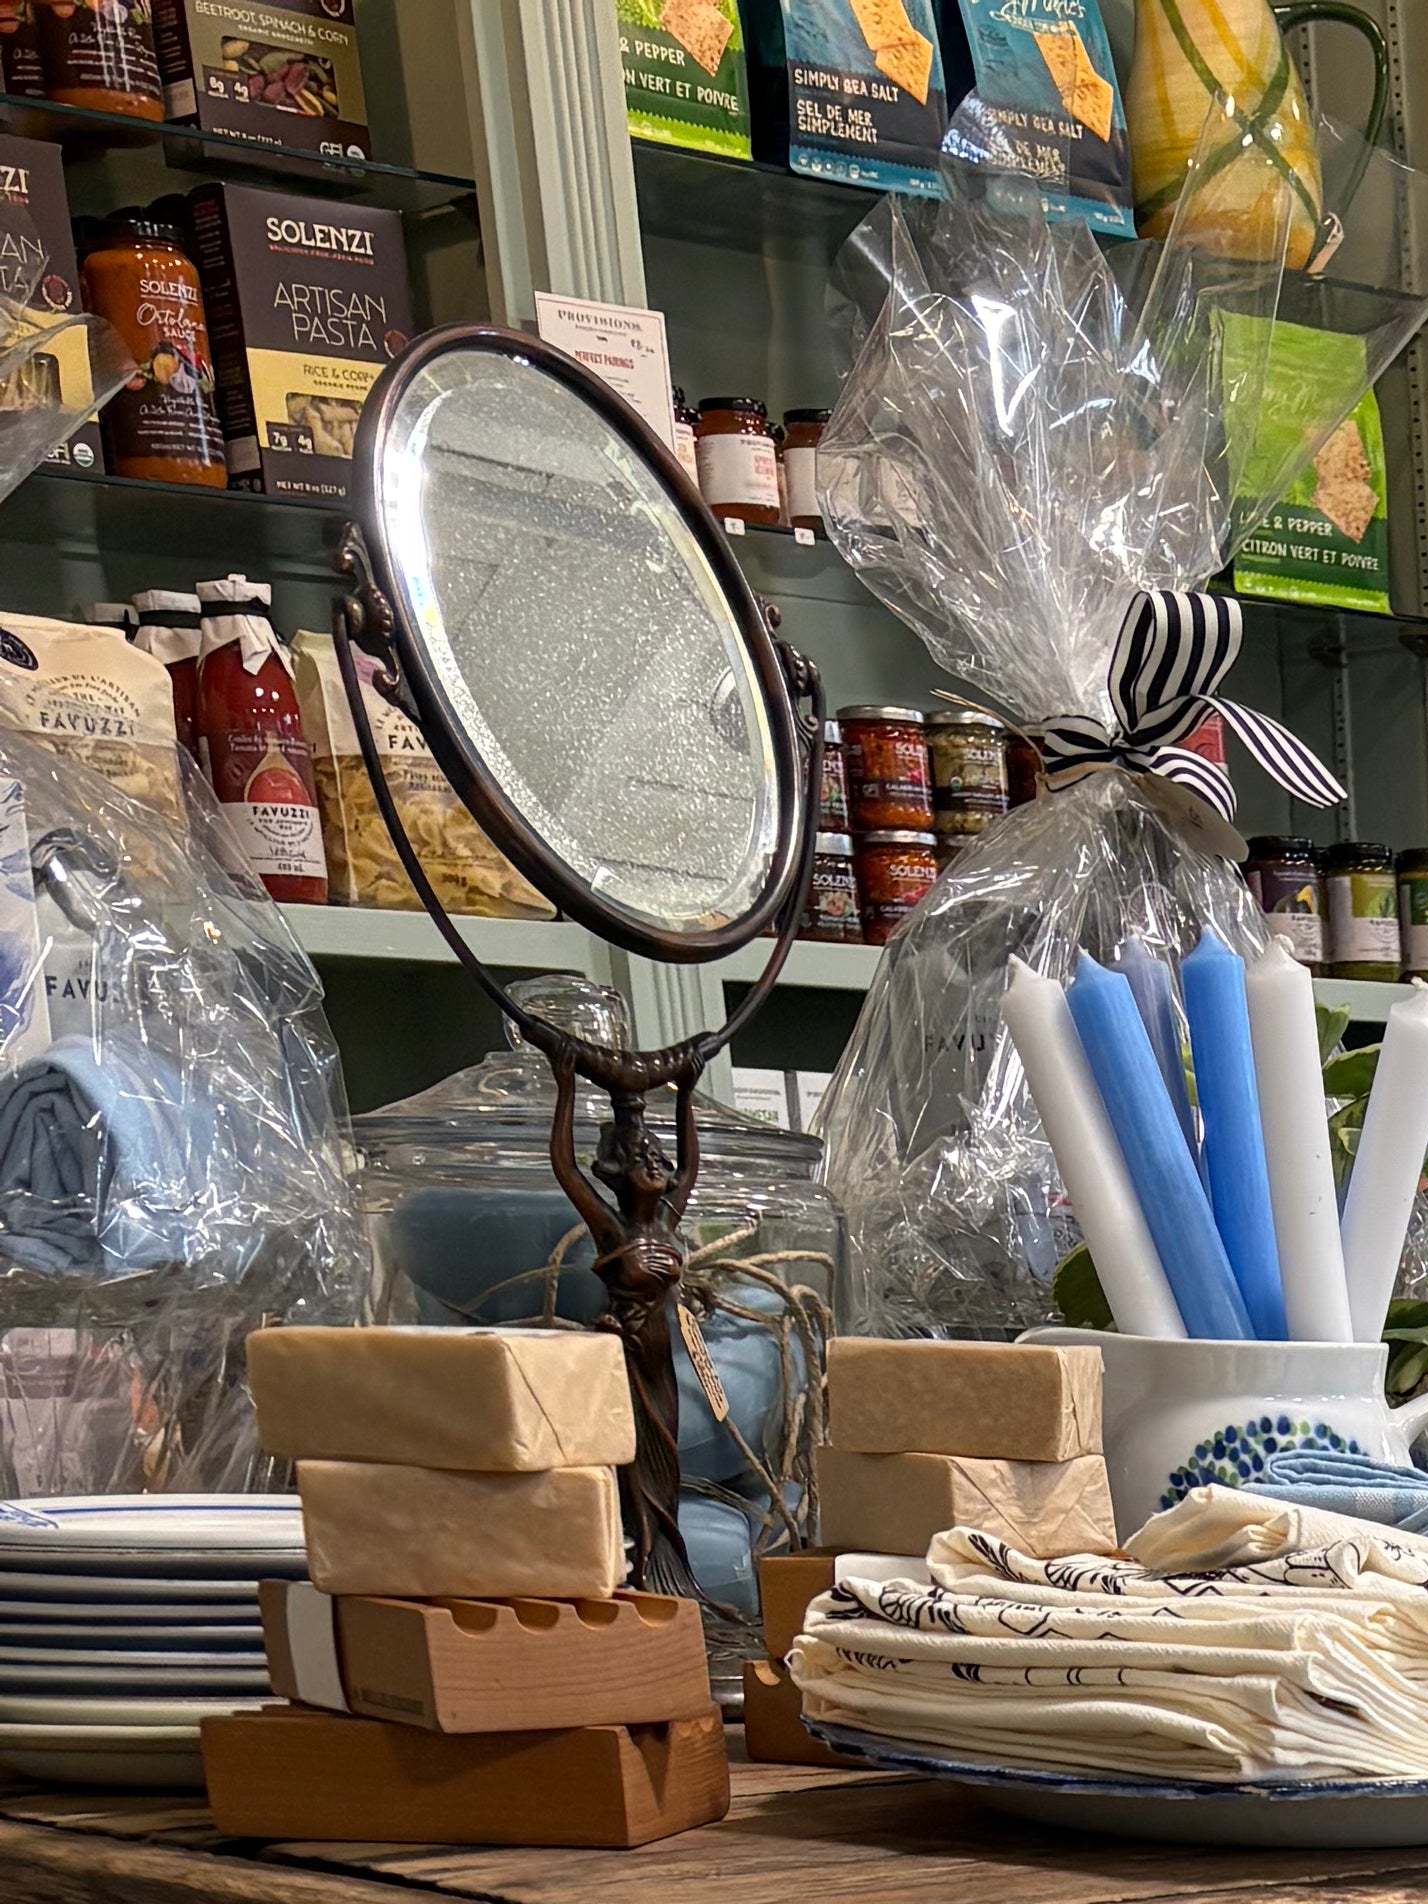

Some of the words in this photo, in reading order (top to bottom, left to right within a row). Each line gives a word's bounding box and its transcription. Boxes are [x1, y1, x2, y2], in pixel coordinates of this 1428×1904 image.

[258, 13, 307, 36] SPINACH
[633, 39, 685, 67] PEPPER
[639, 72, 671, 94] VERT
[675, 80, 692, 99] ET
[696, 86, 740, 112] POIVRE
[794, 68, 839, 91] SIMPLY
[870, 83, 900, 103] SALT
[796, 99, 823, 118] SEL
[826, 104, 842, 121] DE
[847, 108, 873, 126] MER
[265, 216, 375, 257] SOLENZI
[139, 279, 199, 302] SOLENZI
[273, 281, 388, 325] ARTISAN
[290, 312, 378, 351] PASTA
[303, 363, 330, 379] RICE
[1273, 515, 1284, 530] &
[1287, 518, 1334, 537] PEPPER
[1241, 538, 1288, 558] CITRON
[1290, 544, 1320, 562] VERT
[1322, 550, 1338, 565] ET
[1340, 552, 1381, 572] POIVRE
[39, 711, 136, 738] FAVUZZI
[252, 805, 311, 820] FAVUZZI
